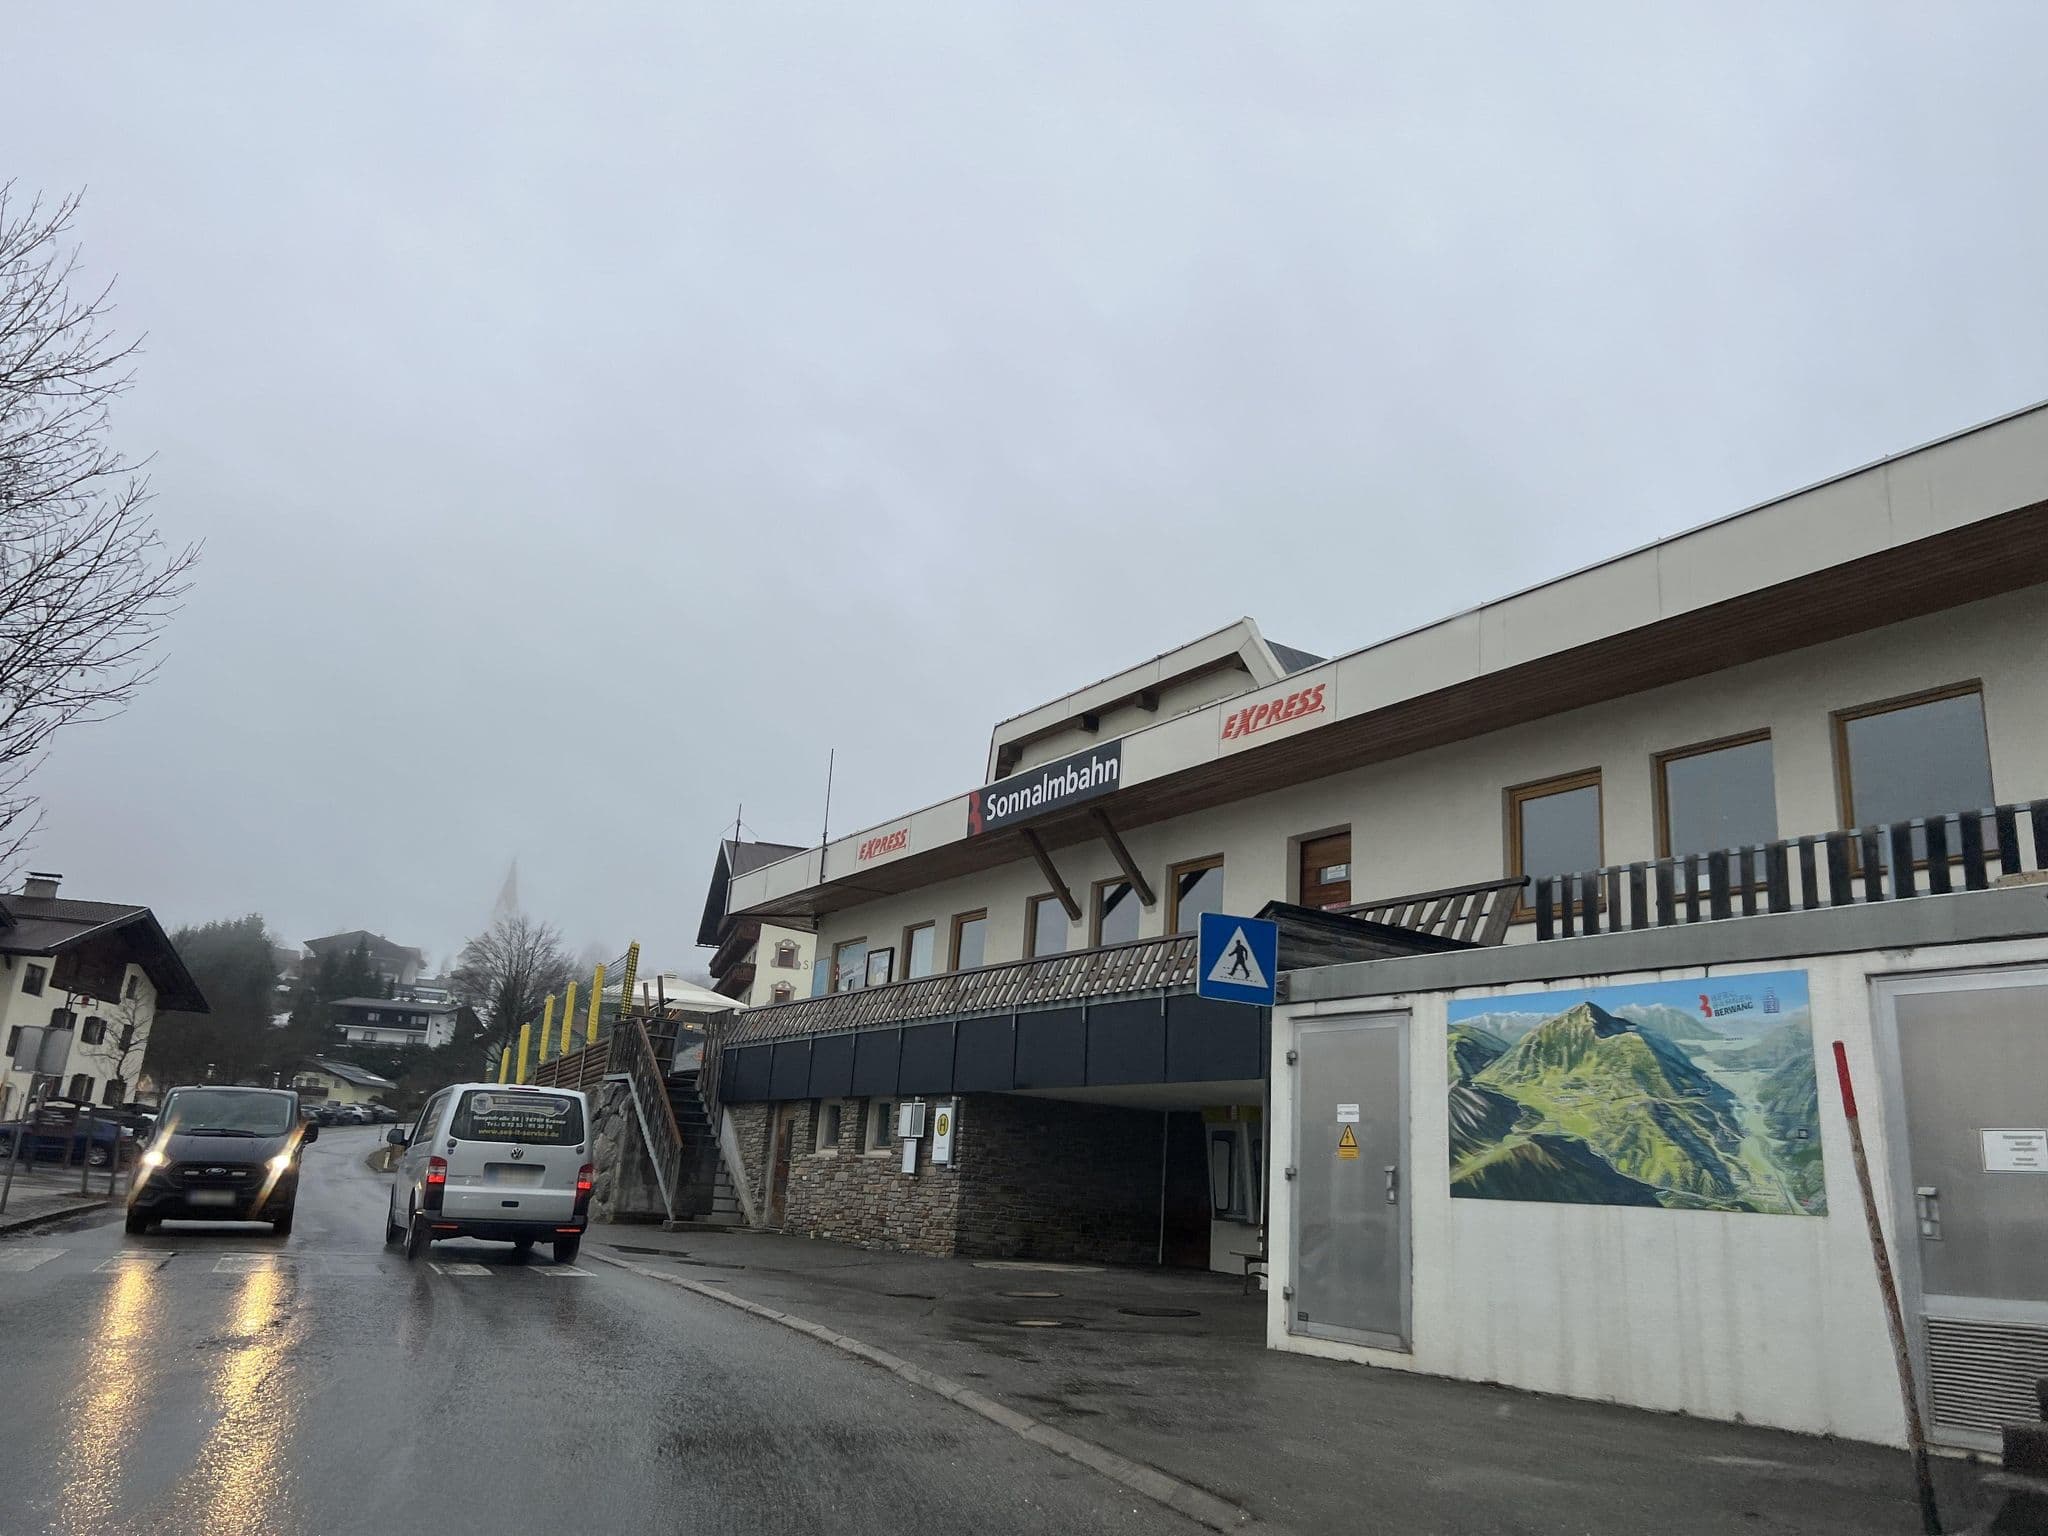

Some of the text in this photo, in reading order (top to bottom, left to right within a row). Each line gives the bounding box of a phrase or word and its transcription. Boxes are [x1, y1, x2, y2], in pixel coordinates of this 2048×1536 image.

[1221, 683, 1326, 740] EXPRESS
[986, 756, 1118, 821] Sonnalmbahn
[858, 828, 908, 861] EXPRESS
[1714, 1001, 1754, 1017] BERWANG
